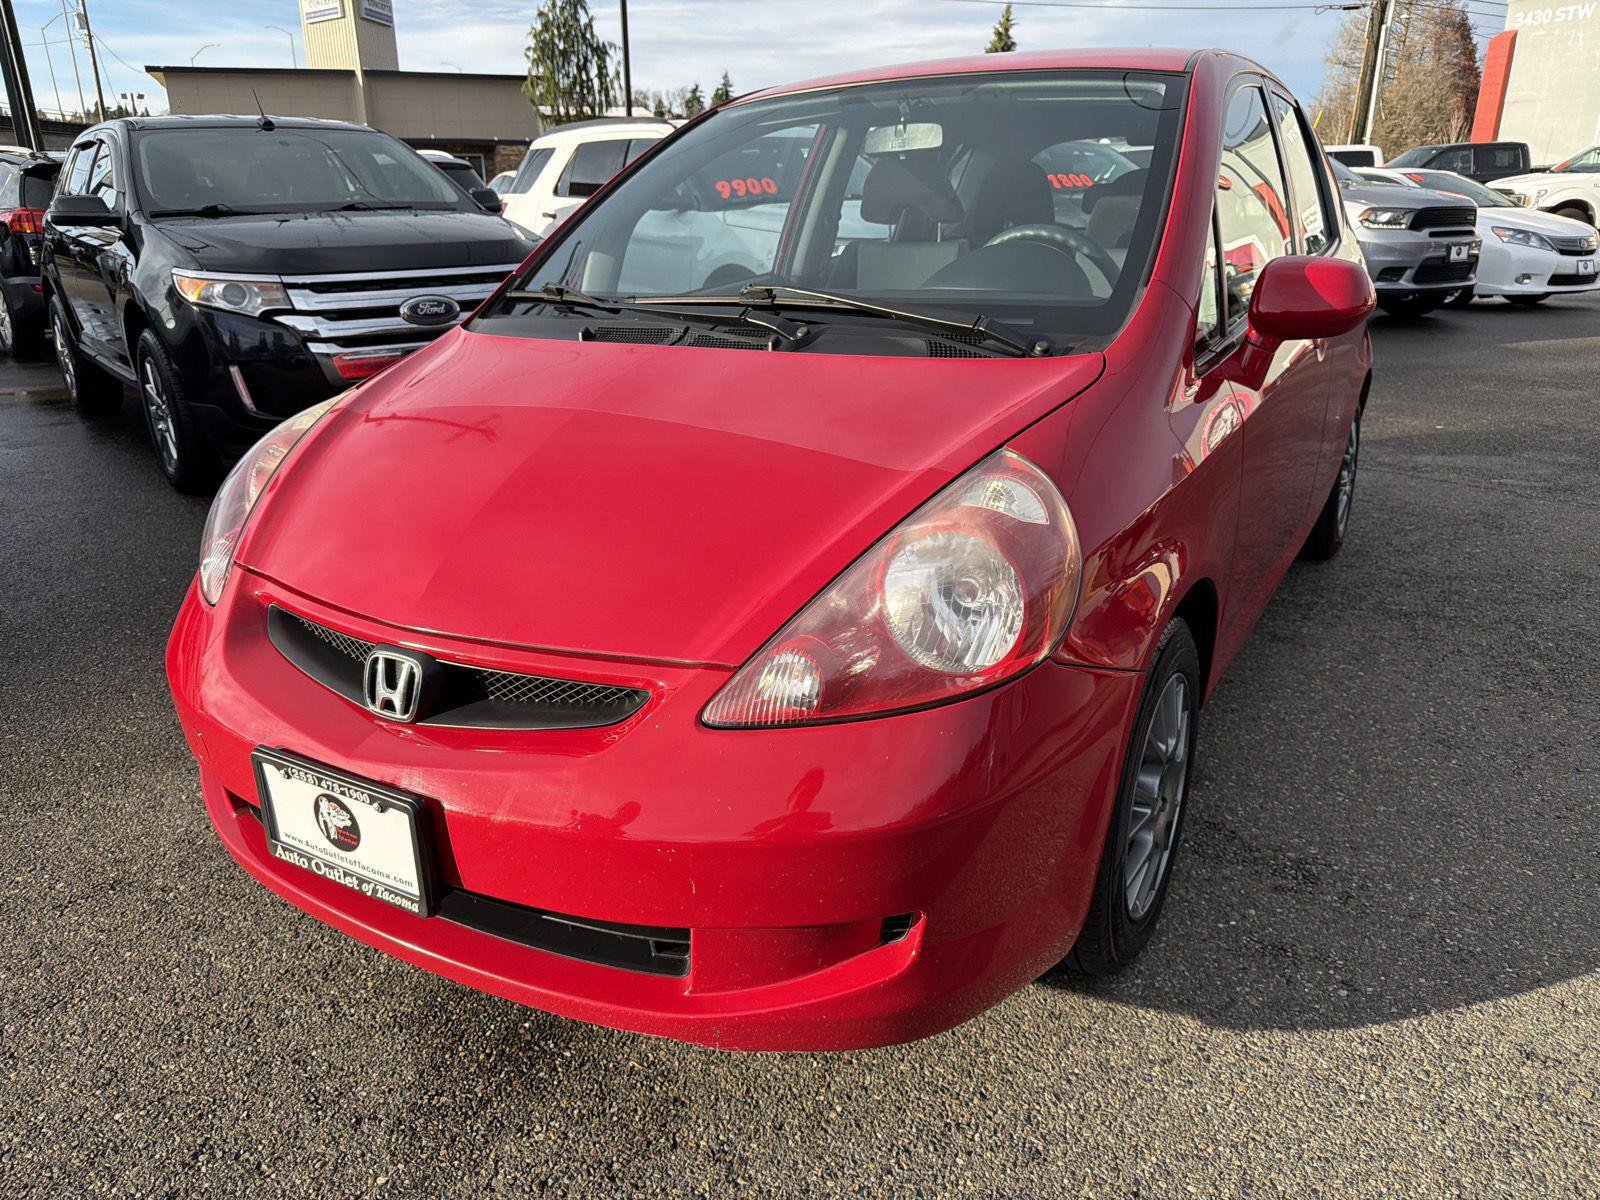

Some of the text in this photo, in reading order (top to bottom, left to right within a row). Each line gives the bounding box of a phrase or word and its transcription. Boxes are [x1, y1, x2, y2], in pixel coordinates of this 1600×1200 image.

[715, 177, 778, 199] 9900
[417, 301, 446, 315] Ford
[275, 844, 419, 913] Auto Outlet of Tacoma
